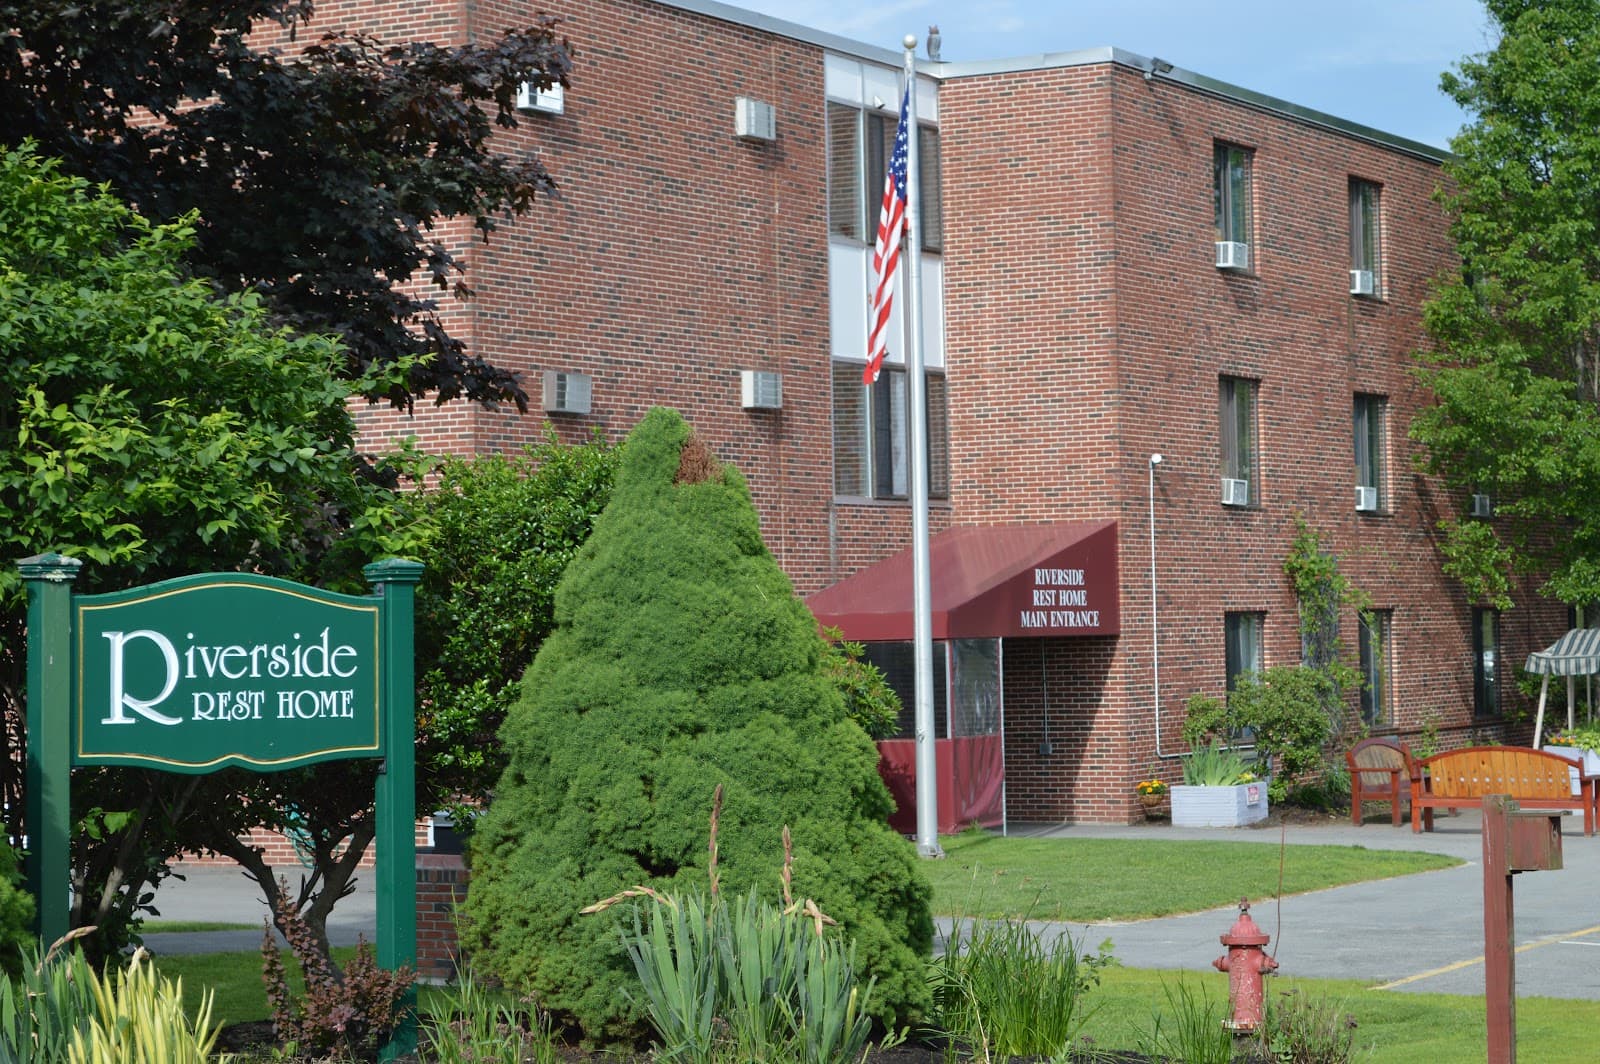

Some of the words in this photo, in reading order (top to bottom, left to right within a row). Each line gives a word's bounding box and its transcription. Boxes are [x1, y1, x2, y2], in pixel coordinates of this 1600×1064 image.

[1035, 568, 1085, 586] RIVERSIDE
[1033, 589, 1056, 606] REST
[1059, 589, 1088, 606] HOME
[1021, 610, 1047, 628] MAIN
[1050, 610, 1100, 627] ENTRANCE
[101, 626, 358, 725] Riverside
[191, 690, 264, 722] REST
[276, 689, 354, 719] HOME
